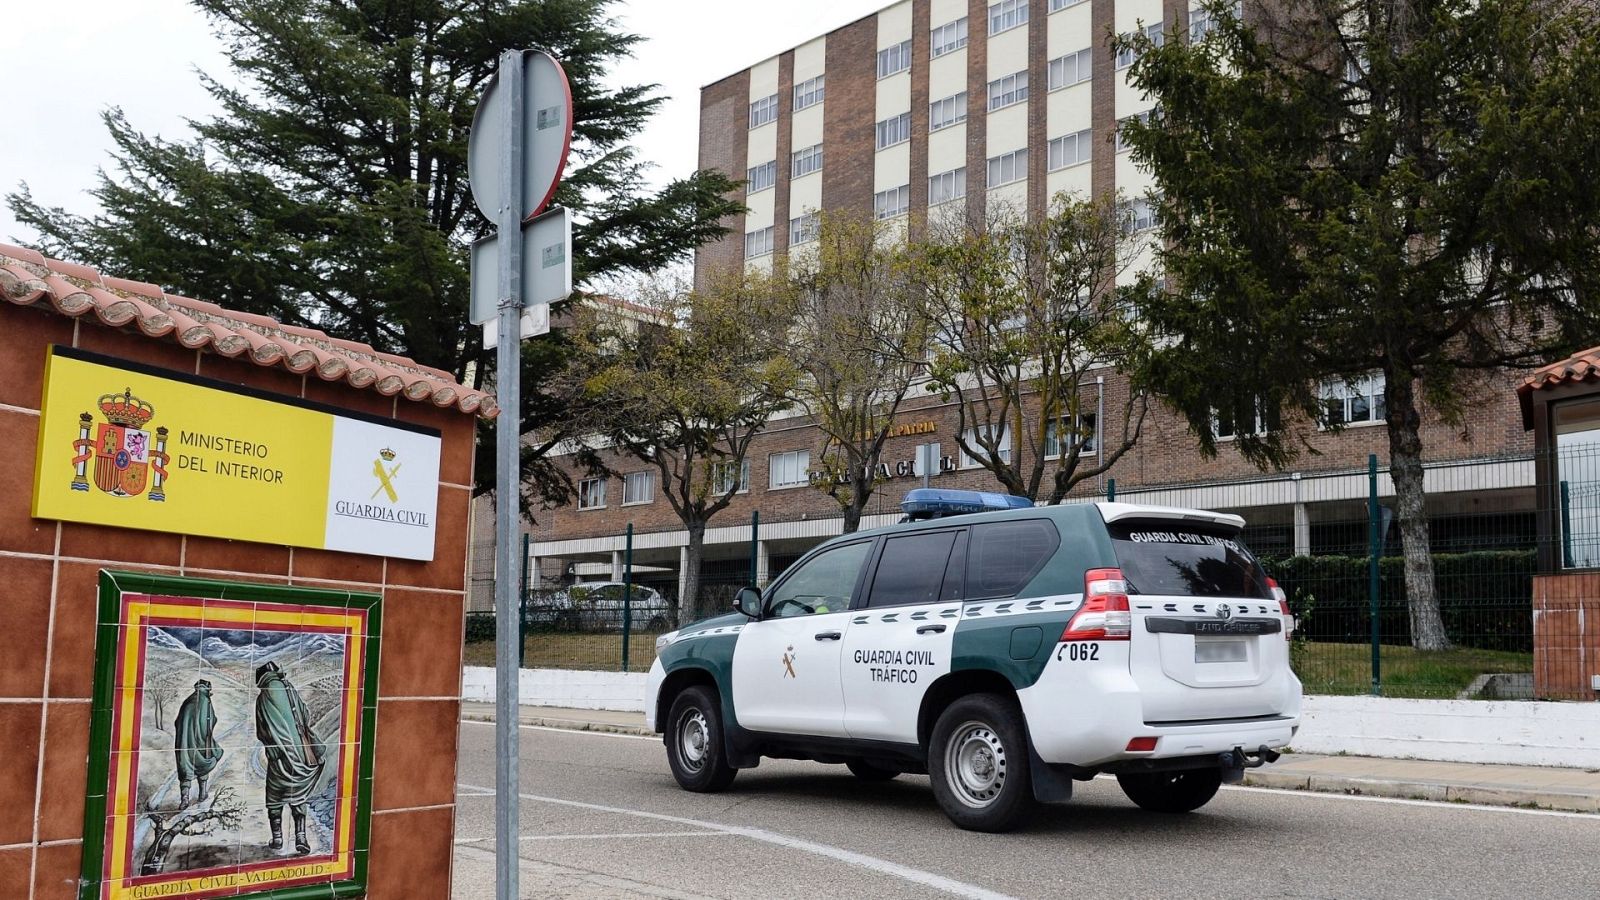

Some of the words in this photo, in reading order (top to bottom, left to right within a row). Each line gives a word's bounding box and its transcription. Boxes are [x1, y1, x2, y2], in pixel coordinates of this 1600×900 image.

[898, 421, 936, 437] PATRIA
[180, 430, 268, 458] MINISTERIO
[178, 454, 208, 474] DEL
[215, 461, 284, 484] INTERIOR
[335, 500, 396, 522] GUARDIA
[397, 509, 430, 527] CIVIL
[1129, 531, 1180, 543] GUARDIA
[1178, 532, 1205, 545] CIVIL
[1195, 622, 1221, 632] LAND
[854, 649, 903, 666] GUARDIA
[906, 650, 936, 666] CIVIL
[1069, 642, 1100, 662] 062
[870, 665, 918, 684] TRÁFICO
[133, 879, 193, 899] GUARDIA
